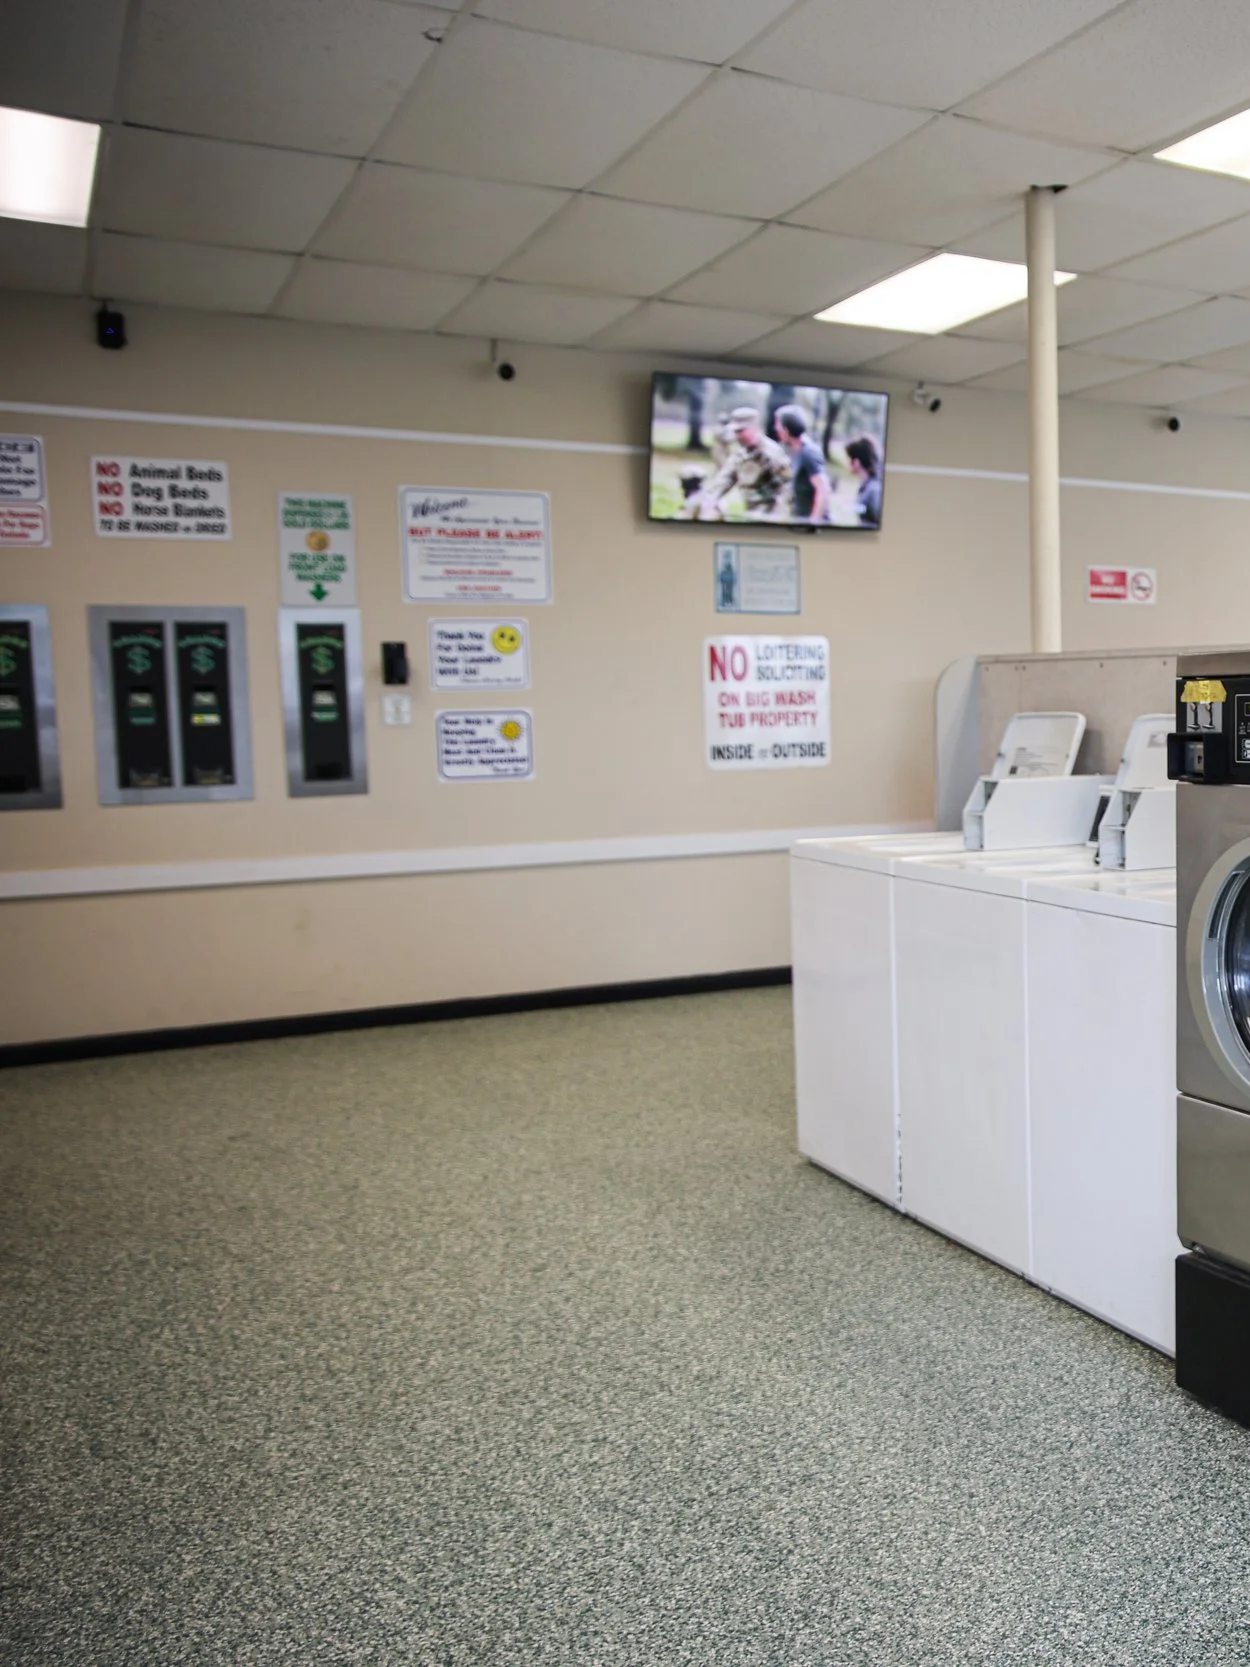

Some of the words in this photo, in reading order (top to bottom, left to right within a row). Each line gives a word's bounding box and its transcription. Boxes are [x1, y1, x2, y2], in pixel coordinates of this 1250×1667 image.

[96, 461, 120, 478] NO
[129, 462, 182, 479] Animal
[185, 465, 223, 481] Beds
[97, 481, 124, 497] NO
[131, 482, 164, 502] Dog
[168, 483, 209, 500] Beds
[98, 500, 124, 517] NO
[132, 502, 169, 517] Horse
[173, 502, 225, 519] Blankets
[709, 643, 748, 682] NO
[756, 644, 825, 661] LOITERING
[757, 664, 825, 681] SOLICITING
[718, 691, 740, 707] ON
[746, 691, 770, 707] BIG
[775, 690, 816, 705] WASH
[718, 712, 745, 728] TUB
[750, 710, 817, 727] PROPERTY
[711, 743, 753, 760] INSIDE
[772, 741, 826, 758] OUTSIDE
